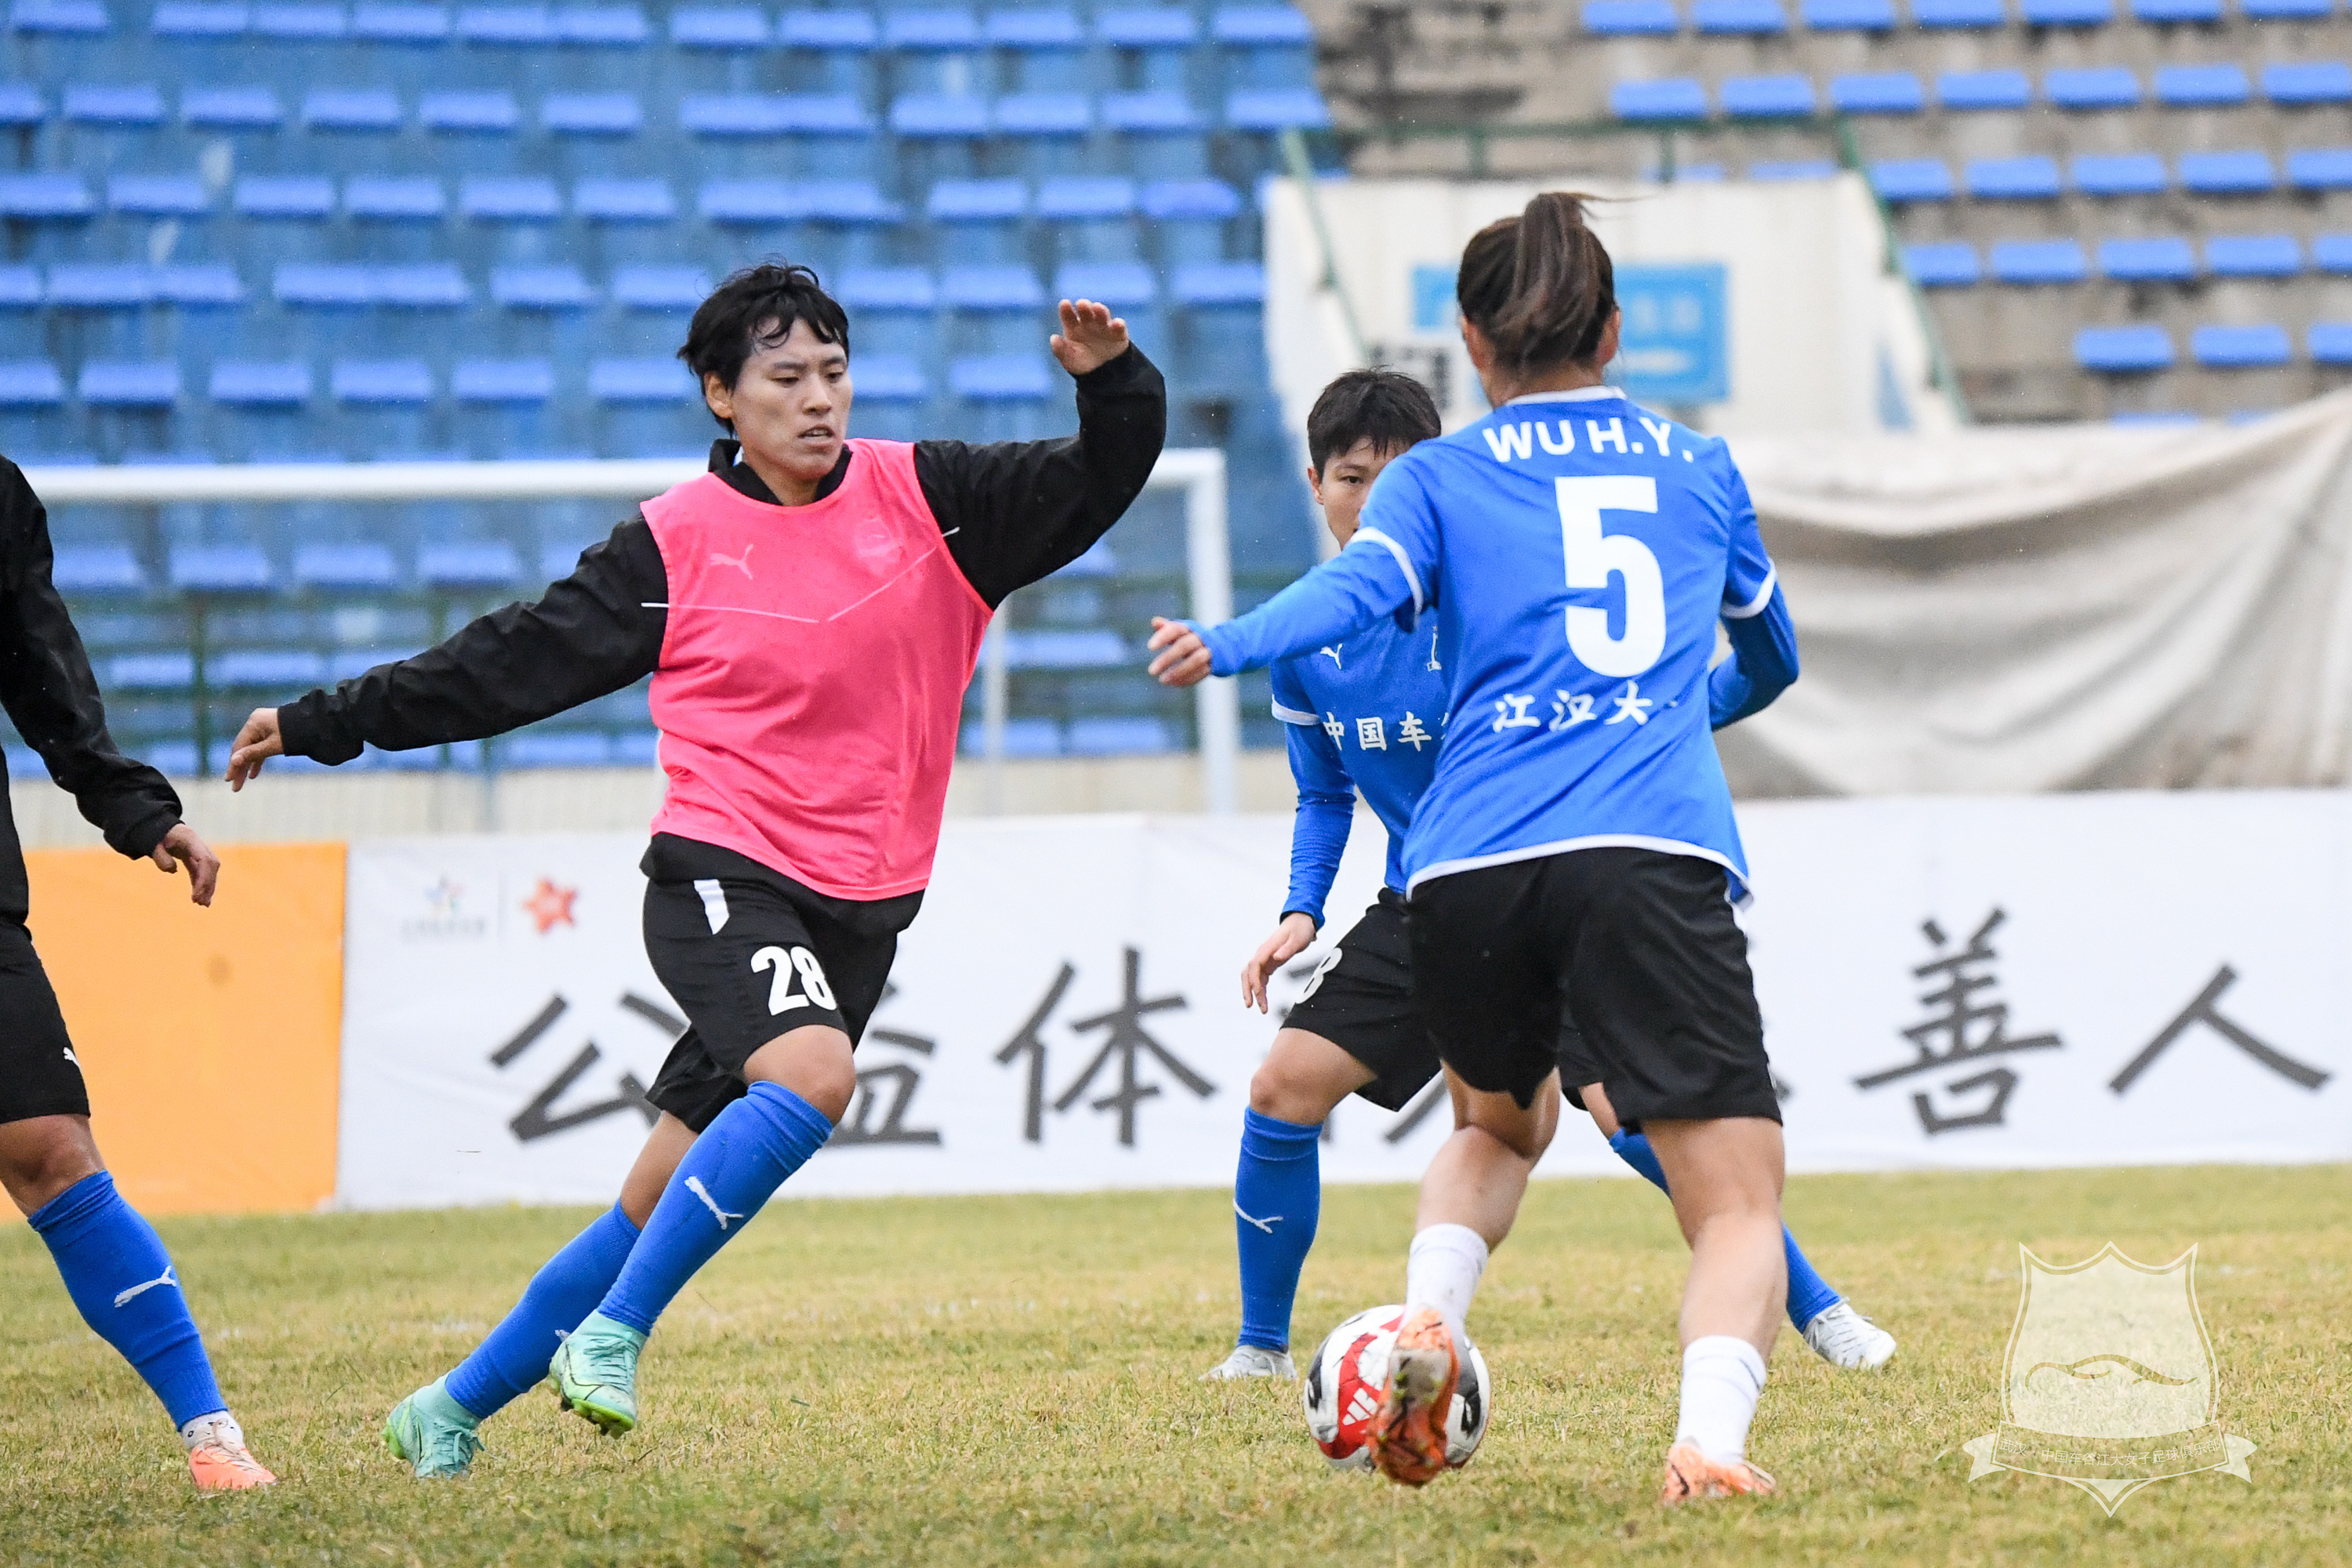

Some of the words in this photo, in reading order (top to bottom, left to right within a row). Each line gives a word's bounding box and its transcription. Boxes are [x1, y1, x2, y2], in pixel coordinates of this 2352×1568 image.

[1483, 419, 1575, 463] WU
[1585, 416, 1694, 463] H.Y.
[1554, 475, 1665, 677] 5
[1323, 710, 1450, 752] 中国车
[1492, 680, 1678, 733] 江汉大
[750, 946, 837, 1015] 28
